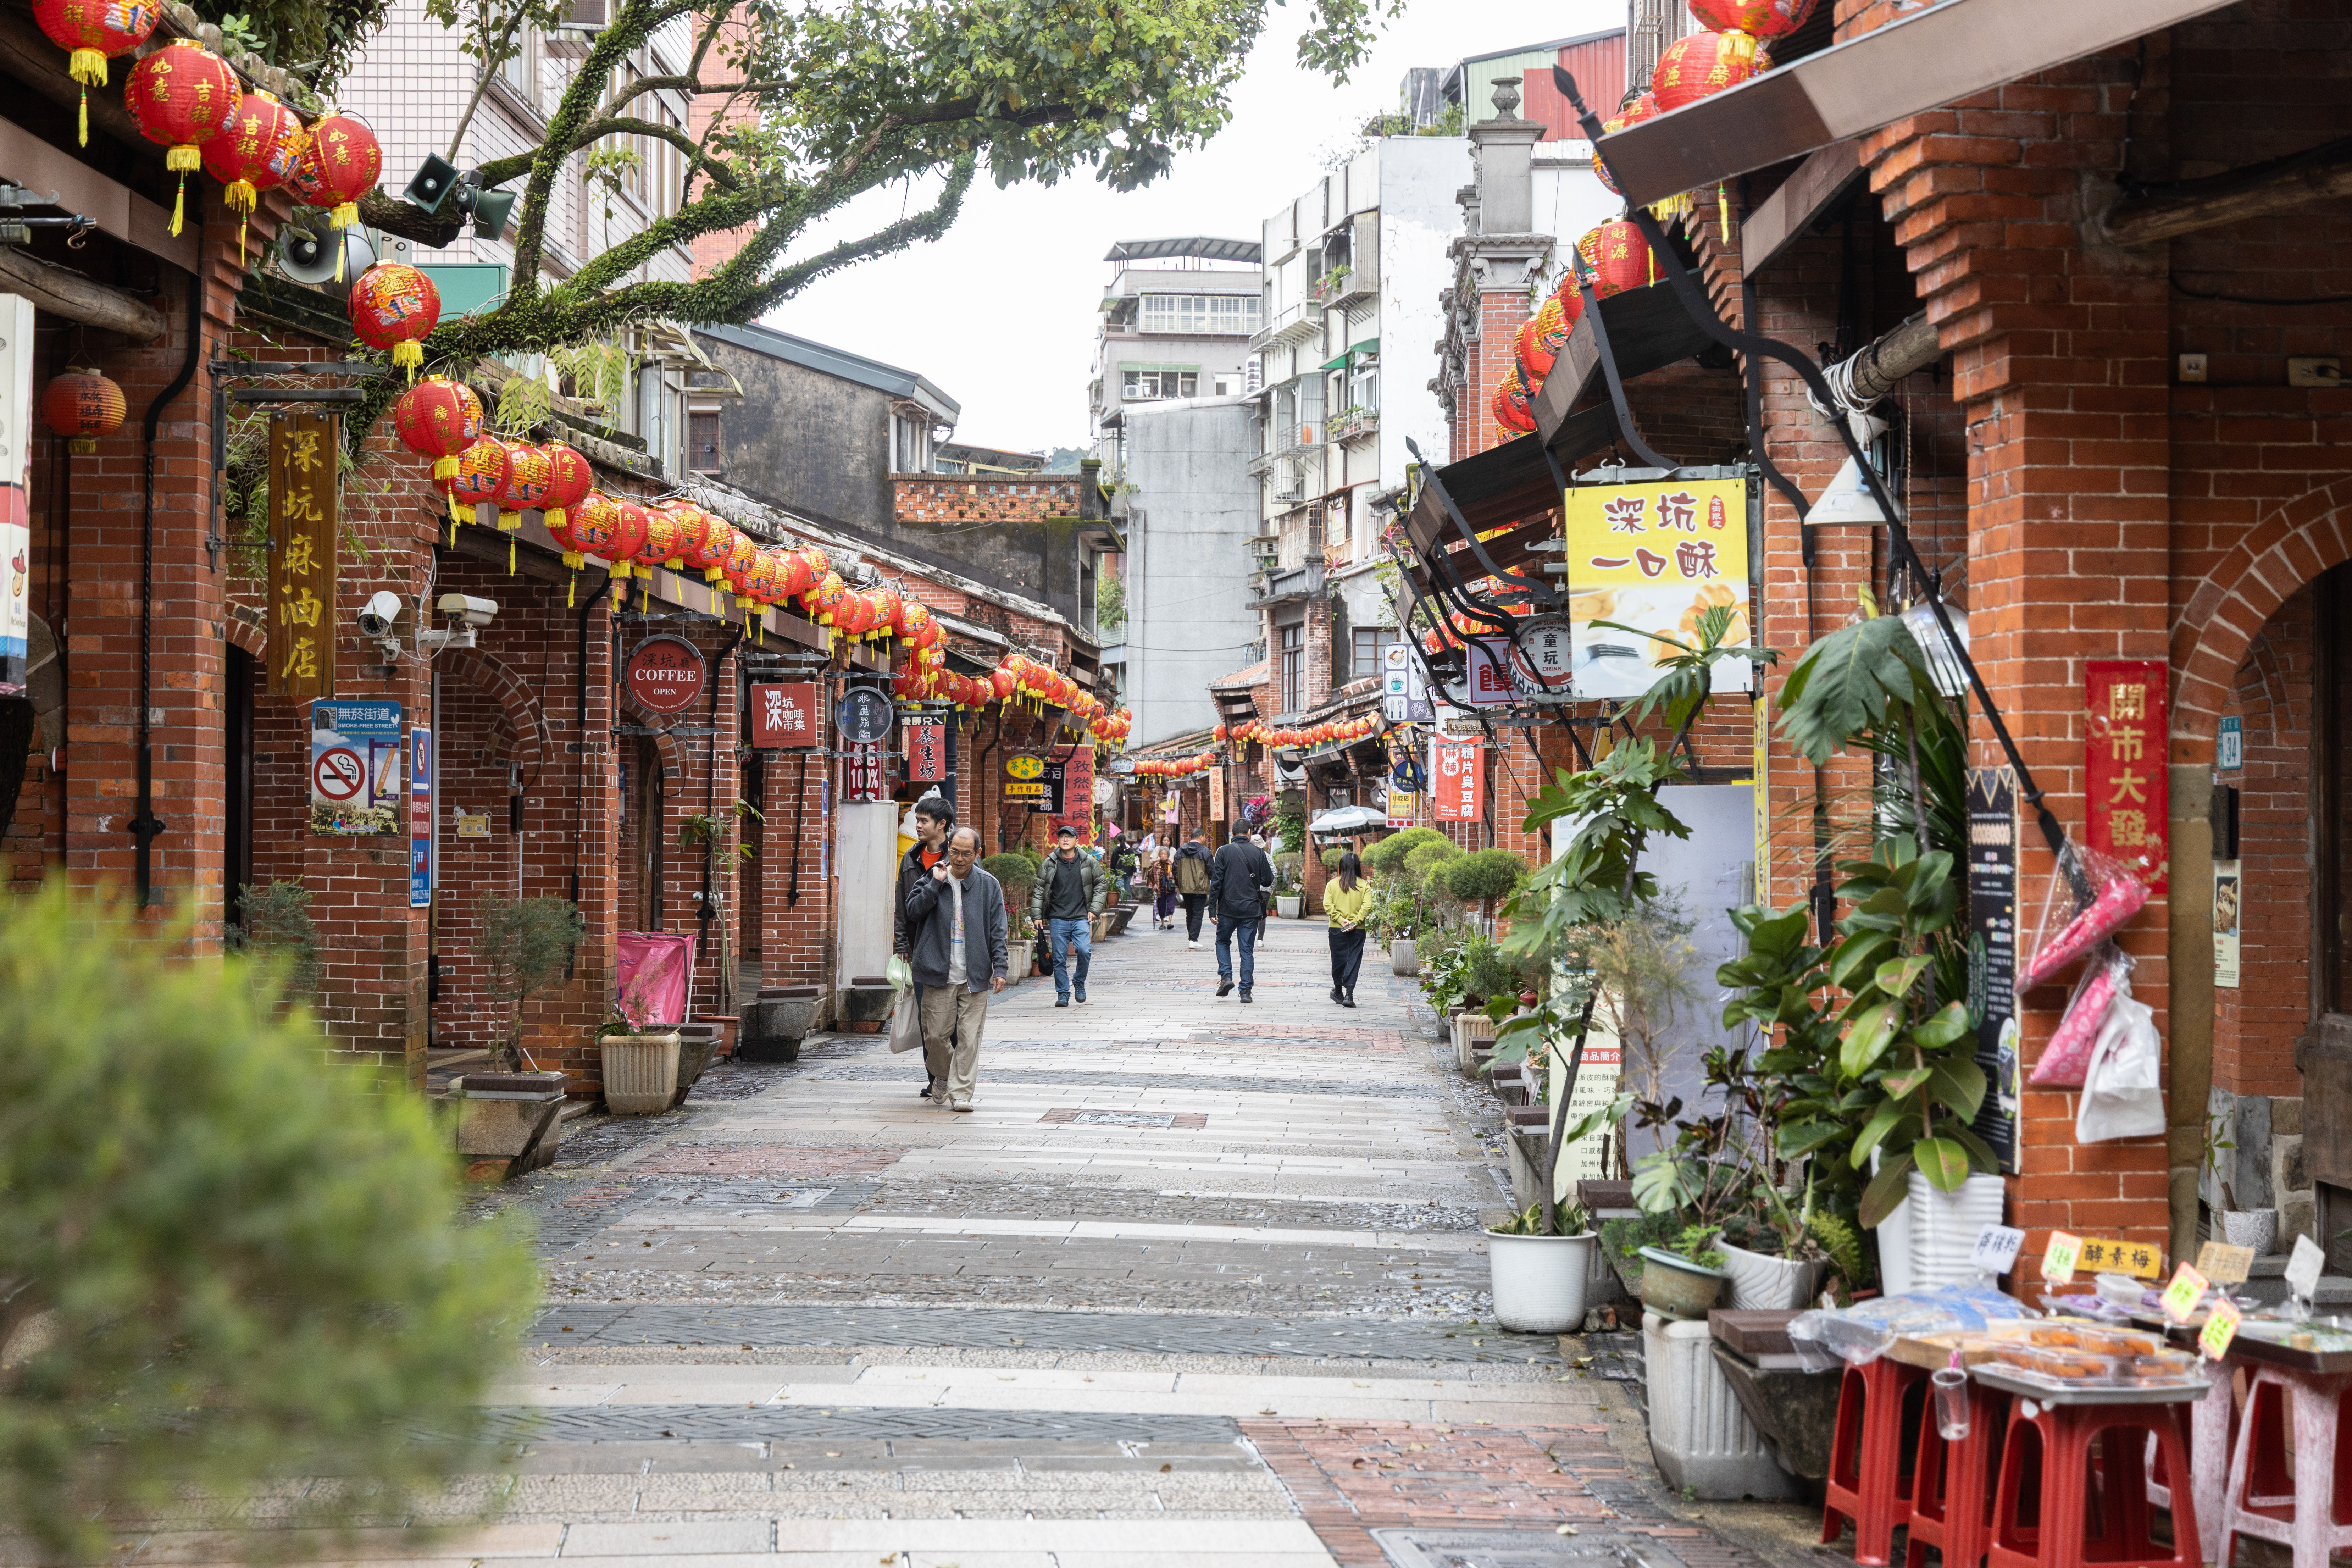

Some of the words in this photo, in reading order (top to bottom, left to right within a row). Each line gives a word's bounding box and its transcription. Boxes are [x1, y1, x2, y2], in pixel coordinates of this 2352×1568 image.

[148, 57, 173, 102] 如意
[1663, 42, 1689, 89] 財源
[190, 77, 214, 128] 吉祥
[237, 113, 262, 161] 吉祥
[328, 128, 351, 166] 如意
[363, 144, 378, 182] 吉祥
[1609, 226, 1629, 261] 財源
[400, 395, 417, 432] 財源
[433, 404, 455, 440] 廣進
[561, 453, 577, 483] 如意
[624, 510, 638, 538] 如意
[1604, 492, 1697, 534] 深坑
[1711, 497, 1723, 528] 老街限定
[280, 429, 323, 679] 深坑麻油店
[1592, 542, 1719, 579] 一口酥
[642, 653, 690, 668] 深坑廳
[1543, 633, 1558, 665] 童玩
[635, 669, 696, 682] COFFEE
[338, 707, 390, 720] 無菸街道
[648, 701, 665, 709] Specialty
[678, 691, 695, 706] Association
[782, 709, 805, 720] 咖啡
[857, 693, 871, 739] 水晶吊飾
[874, 703, 886, 726] 開運
[782, 719, 805, 731] 市集
[915, 726, 939, 780] 養生坊
[2109, 683, 2146, 847] 開市大發
[2227, 736, 2237, 763] 34
[851, 768, 878, 789] 100%
[1072, 760, 1091, 837] 孜然羊肉串
[1580, 1051, 1621, 1062] 商品簡介
[2085, 1245, 2151, 1269] 酵素梅
